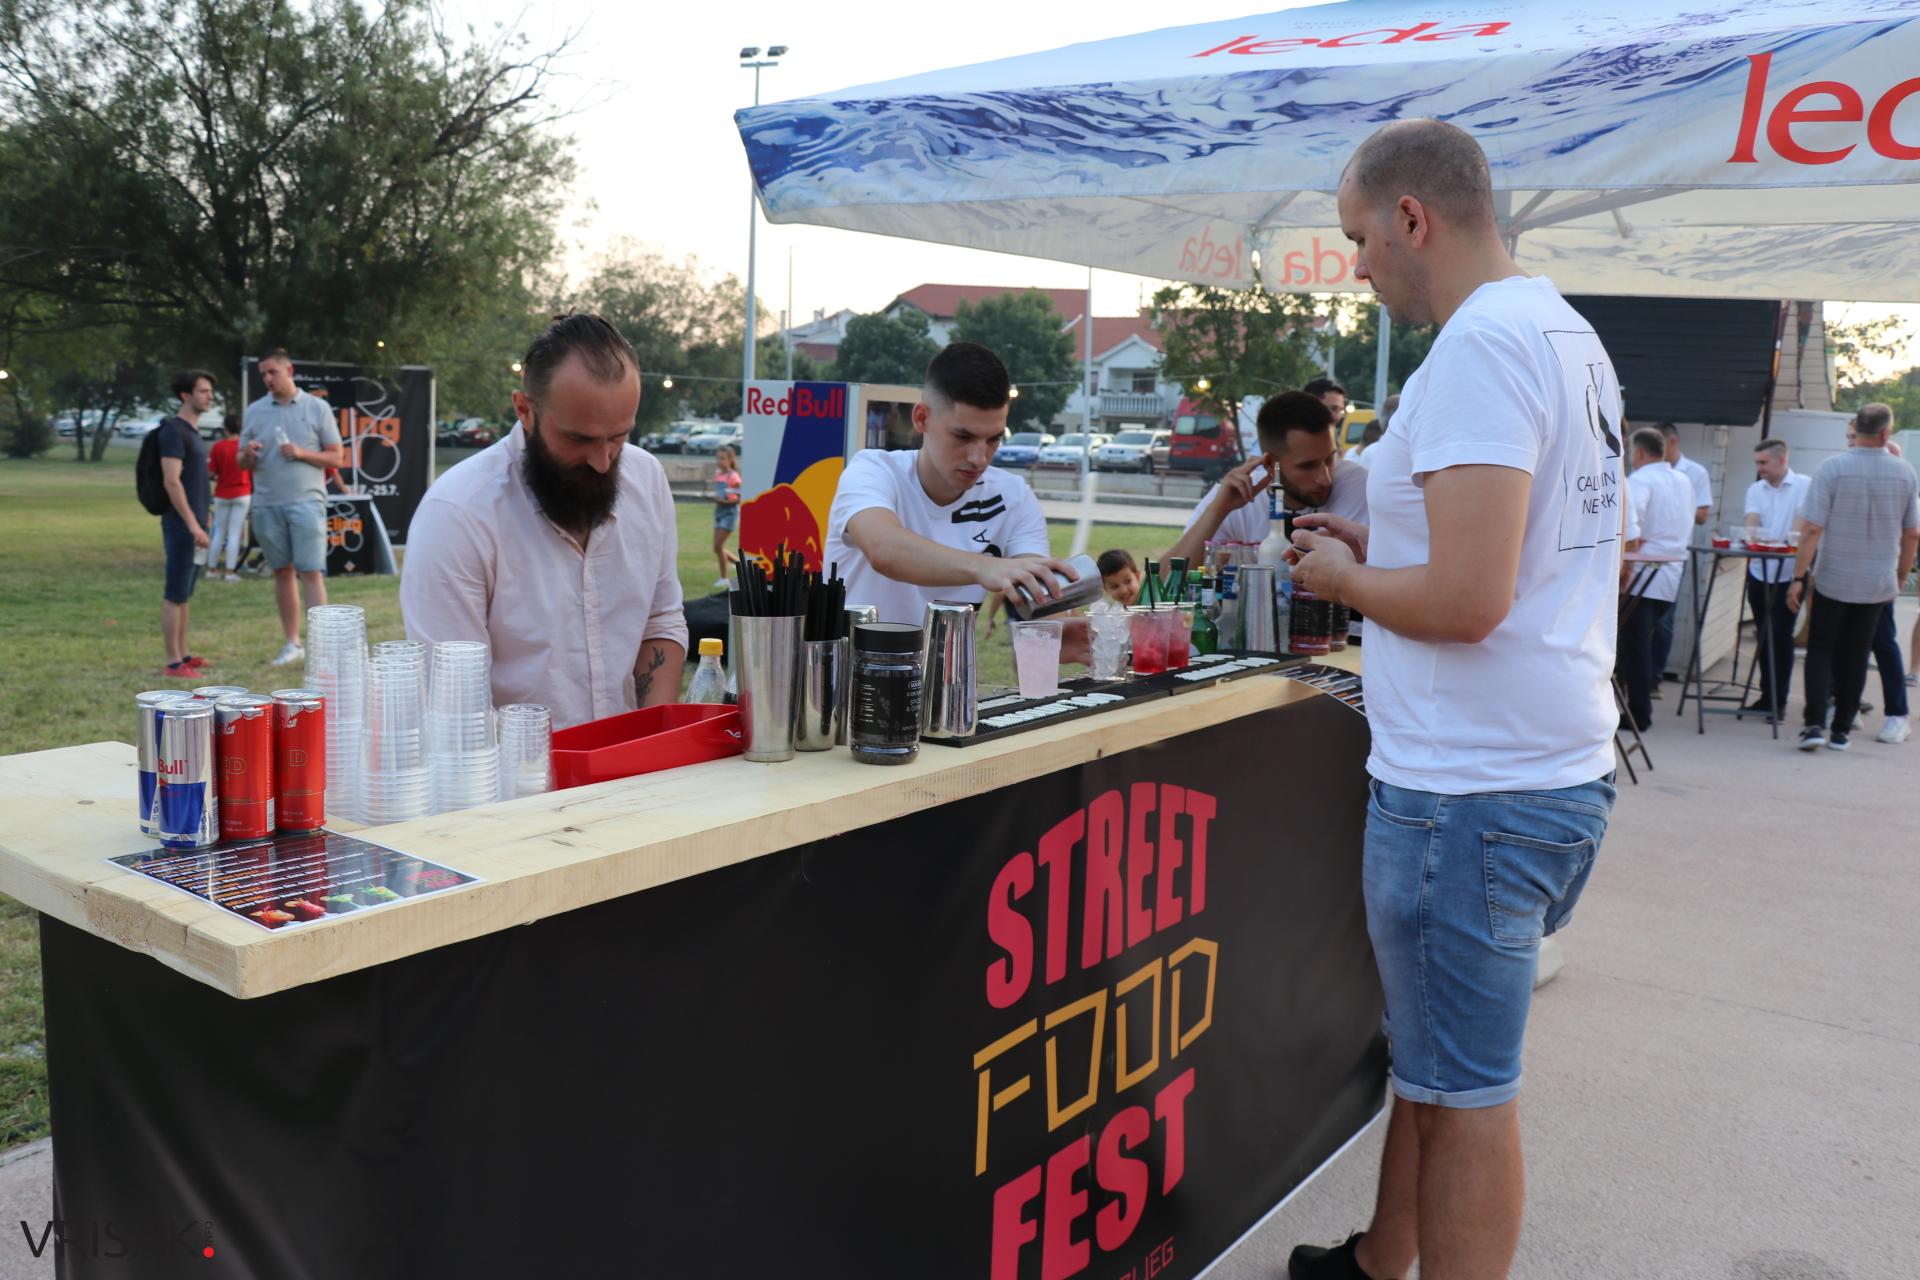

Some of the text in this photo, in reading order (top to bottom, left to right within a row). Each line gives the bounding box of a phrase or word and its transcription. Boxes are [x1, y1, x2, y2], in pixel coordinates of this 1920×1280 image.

[1186, 21, 1512, 58] leda
[747, 387, 844, 418] Red Bull
[158, 758, 184, 775] Bull
[986, 782, 1217, 1009] STREET
[973, 937, 1219, 1177] FOOD
[990, 1067, 1195, 1280] FEST
